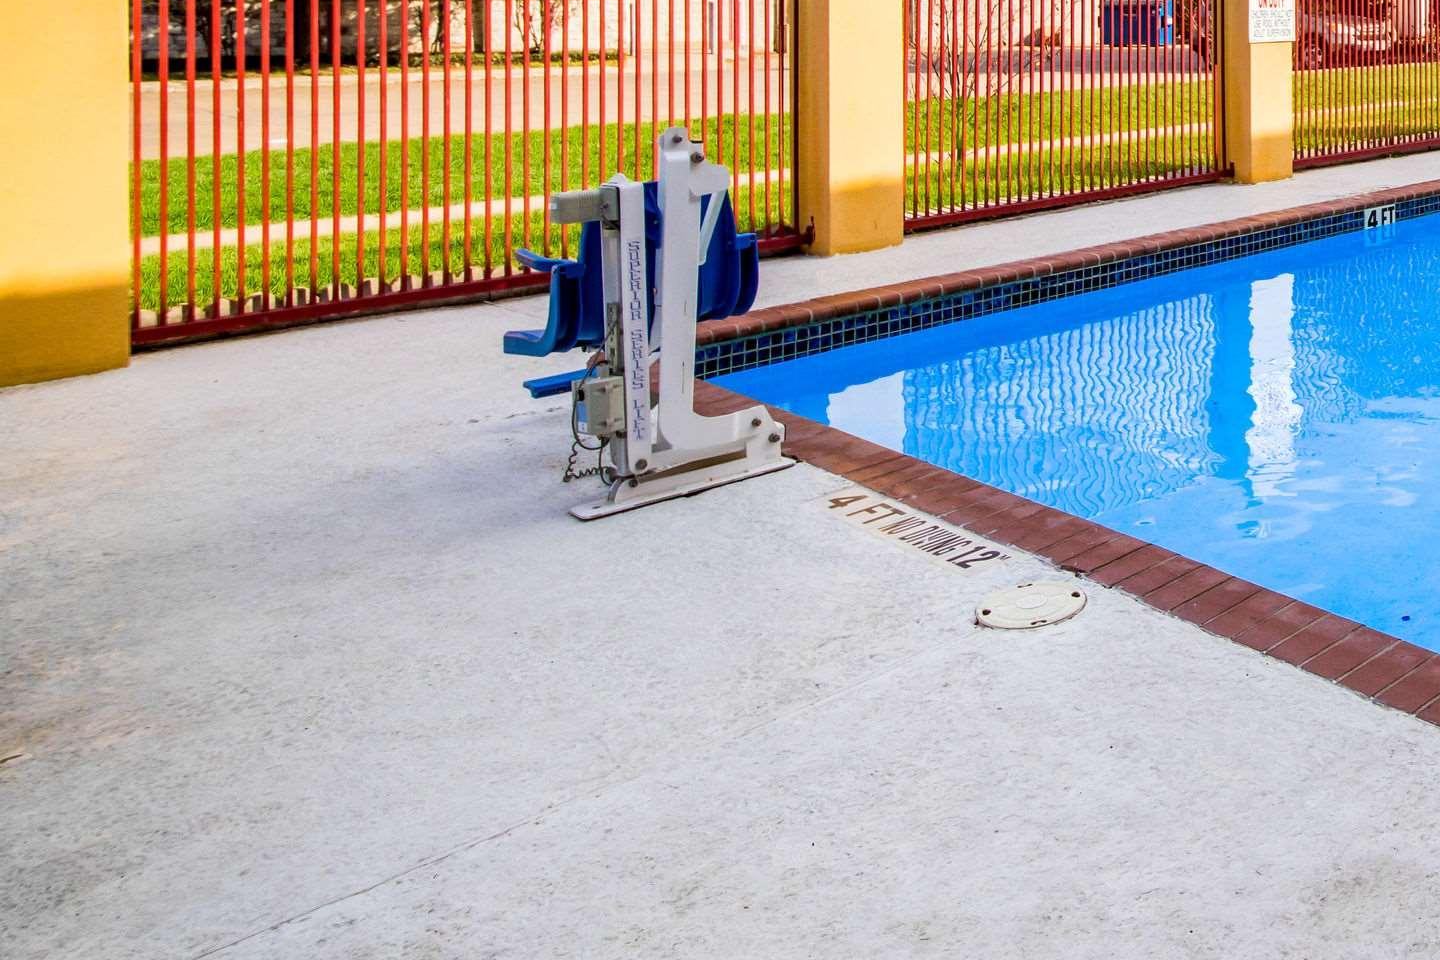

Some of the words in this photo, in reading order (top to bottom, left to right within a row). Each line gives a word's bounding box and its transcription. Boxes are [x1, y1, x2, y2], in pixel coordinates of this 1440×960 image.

[1367, 209, 1378, 227] 4
[1381, 206, 1395, 225] FT
[829, 495, 869, 509] 4
[846, 503, 907, 525] FT
[878, 516, 927, 535] NO
[898, 525, 973, 556] DIVING
